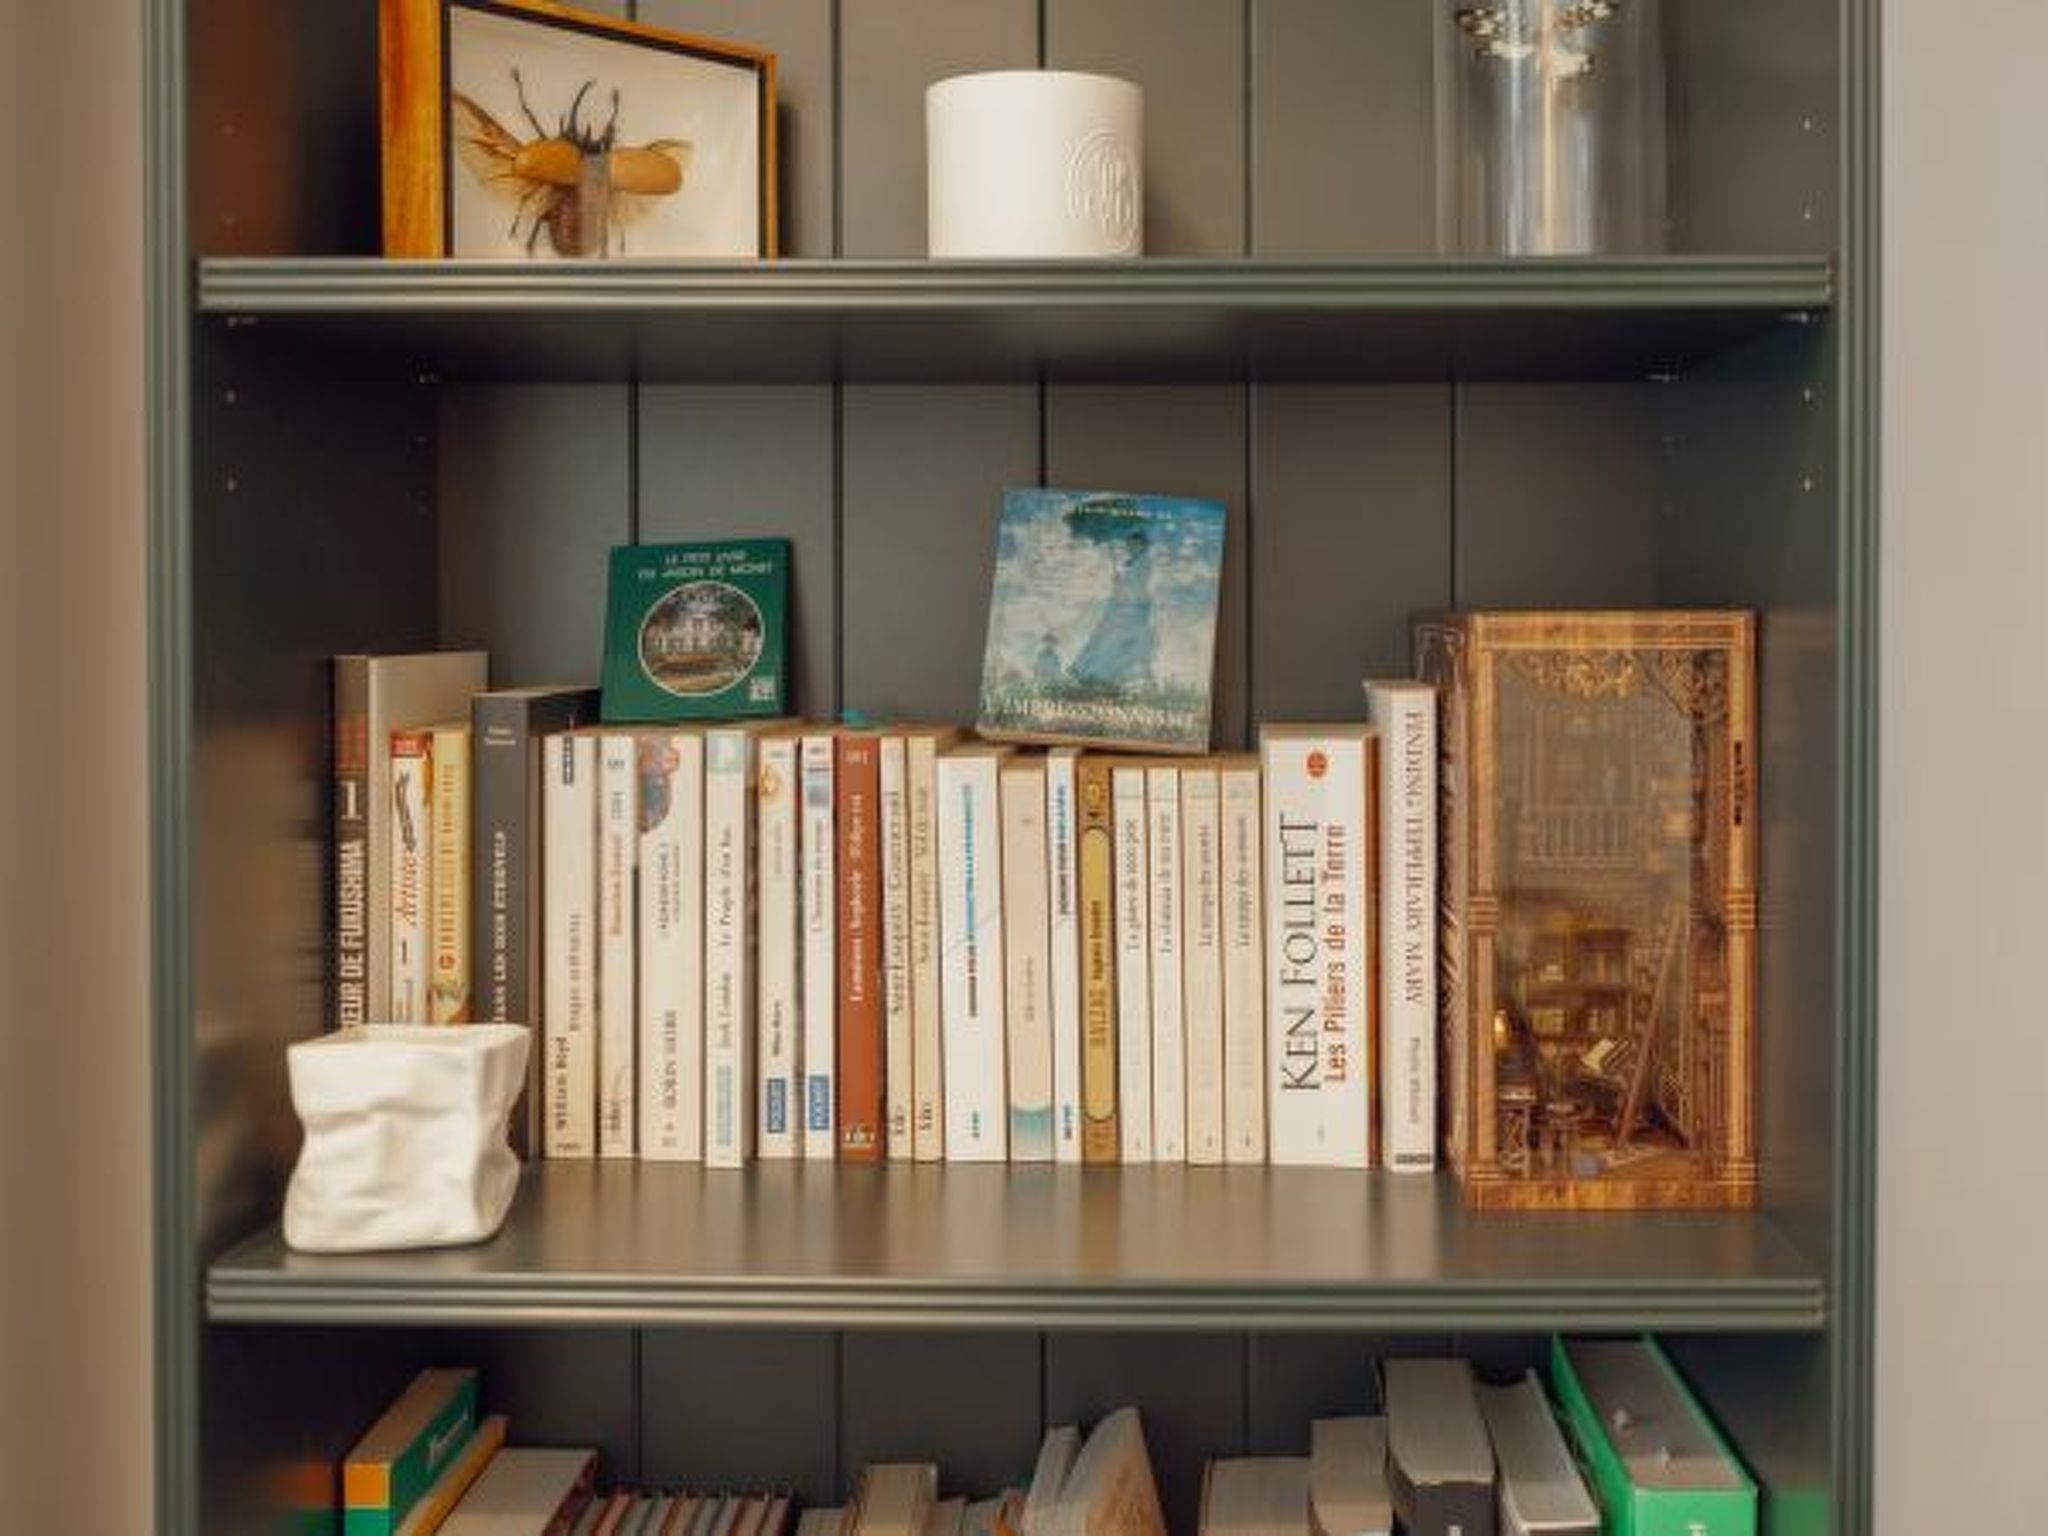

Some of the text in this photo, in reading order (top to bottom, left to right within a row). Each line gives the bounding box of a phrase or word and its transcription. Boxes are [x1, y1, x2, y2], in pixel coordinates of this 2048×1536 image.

[1405, 712, 1425, 809] FINDING
[340, 839, 364, 949] FUKUSHIMA
[340, 953, 363, 977] DE
[1279, 811, 1321, 1090] KEN FOLLETT
[1320, 823, 1347, 1083] Les Piliers de la Terre
[1405, 942, 1424, 1005] MARY
